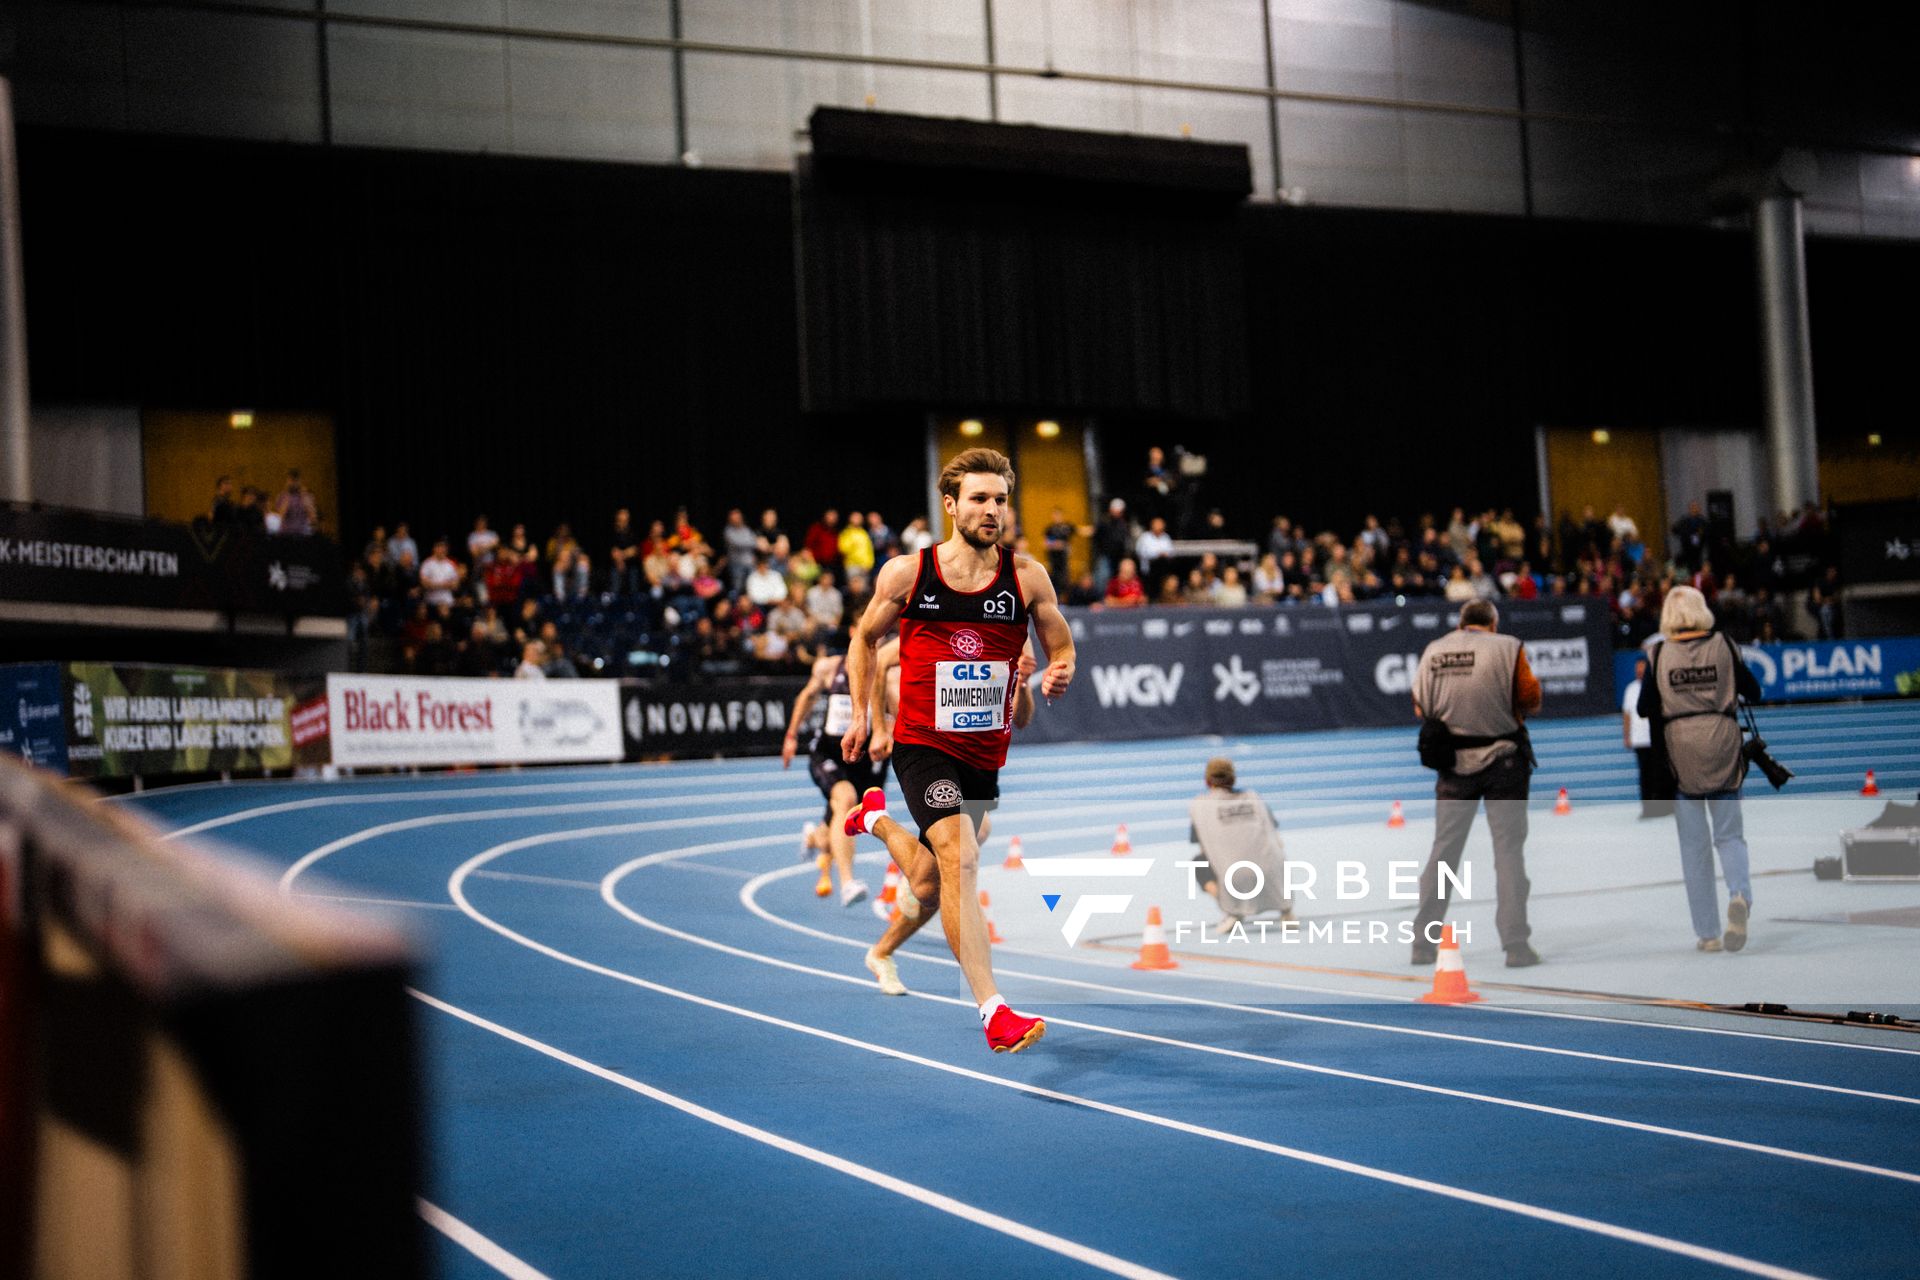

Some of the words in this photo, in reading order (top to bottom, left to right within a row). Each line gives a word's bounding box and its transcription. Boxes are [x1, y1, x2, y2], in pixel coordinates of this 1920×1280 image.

[983, 600, 1006, 614] OS
[1782, 645, 1882, 679] PLAN
[1090, 662, 1184, 707] WGV
[344, 690, 410, 731] Black
[417, 692, 493, 731] Forest
[646, 699, 785, 734] NOVAFON
[971, 714, 992, 722] PLAN
